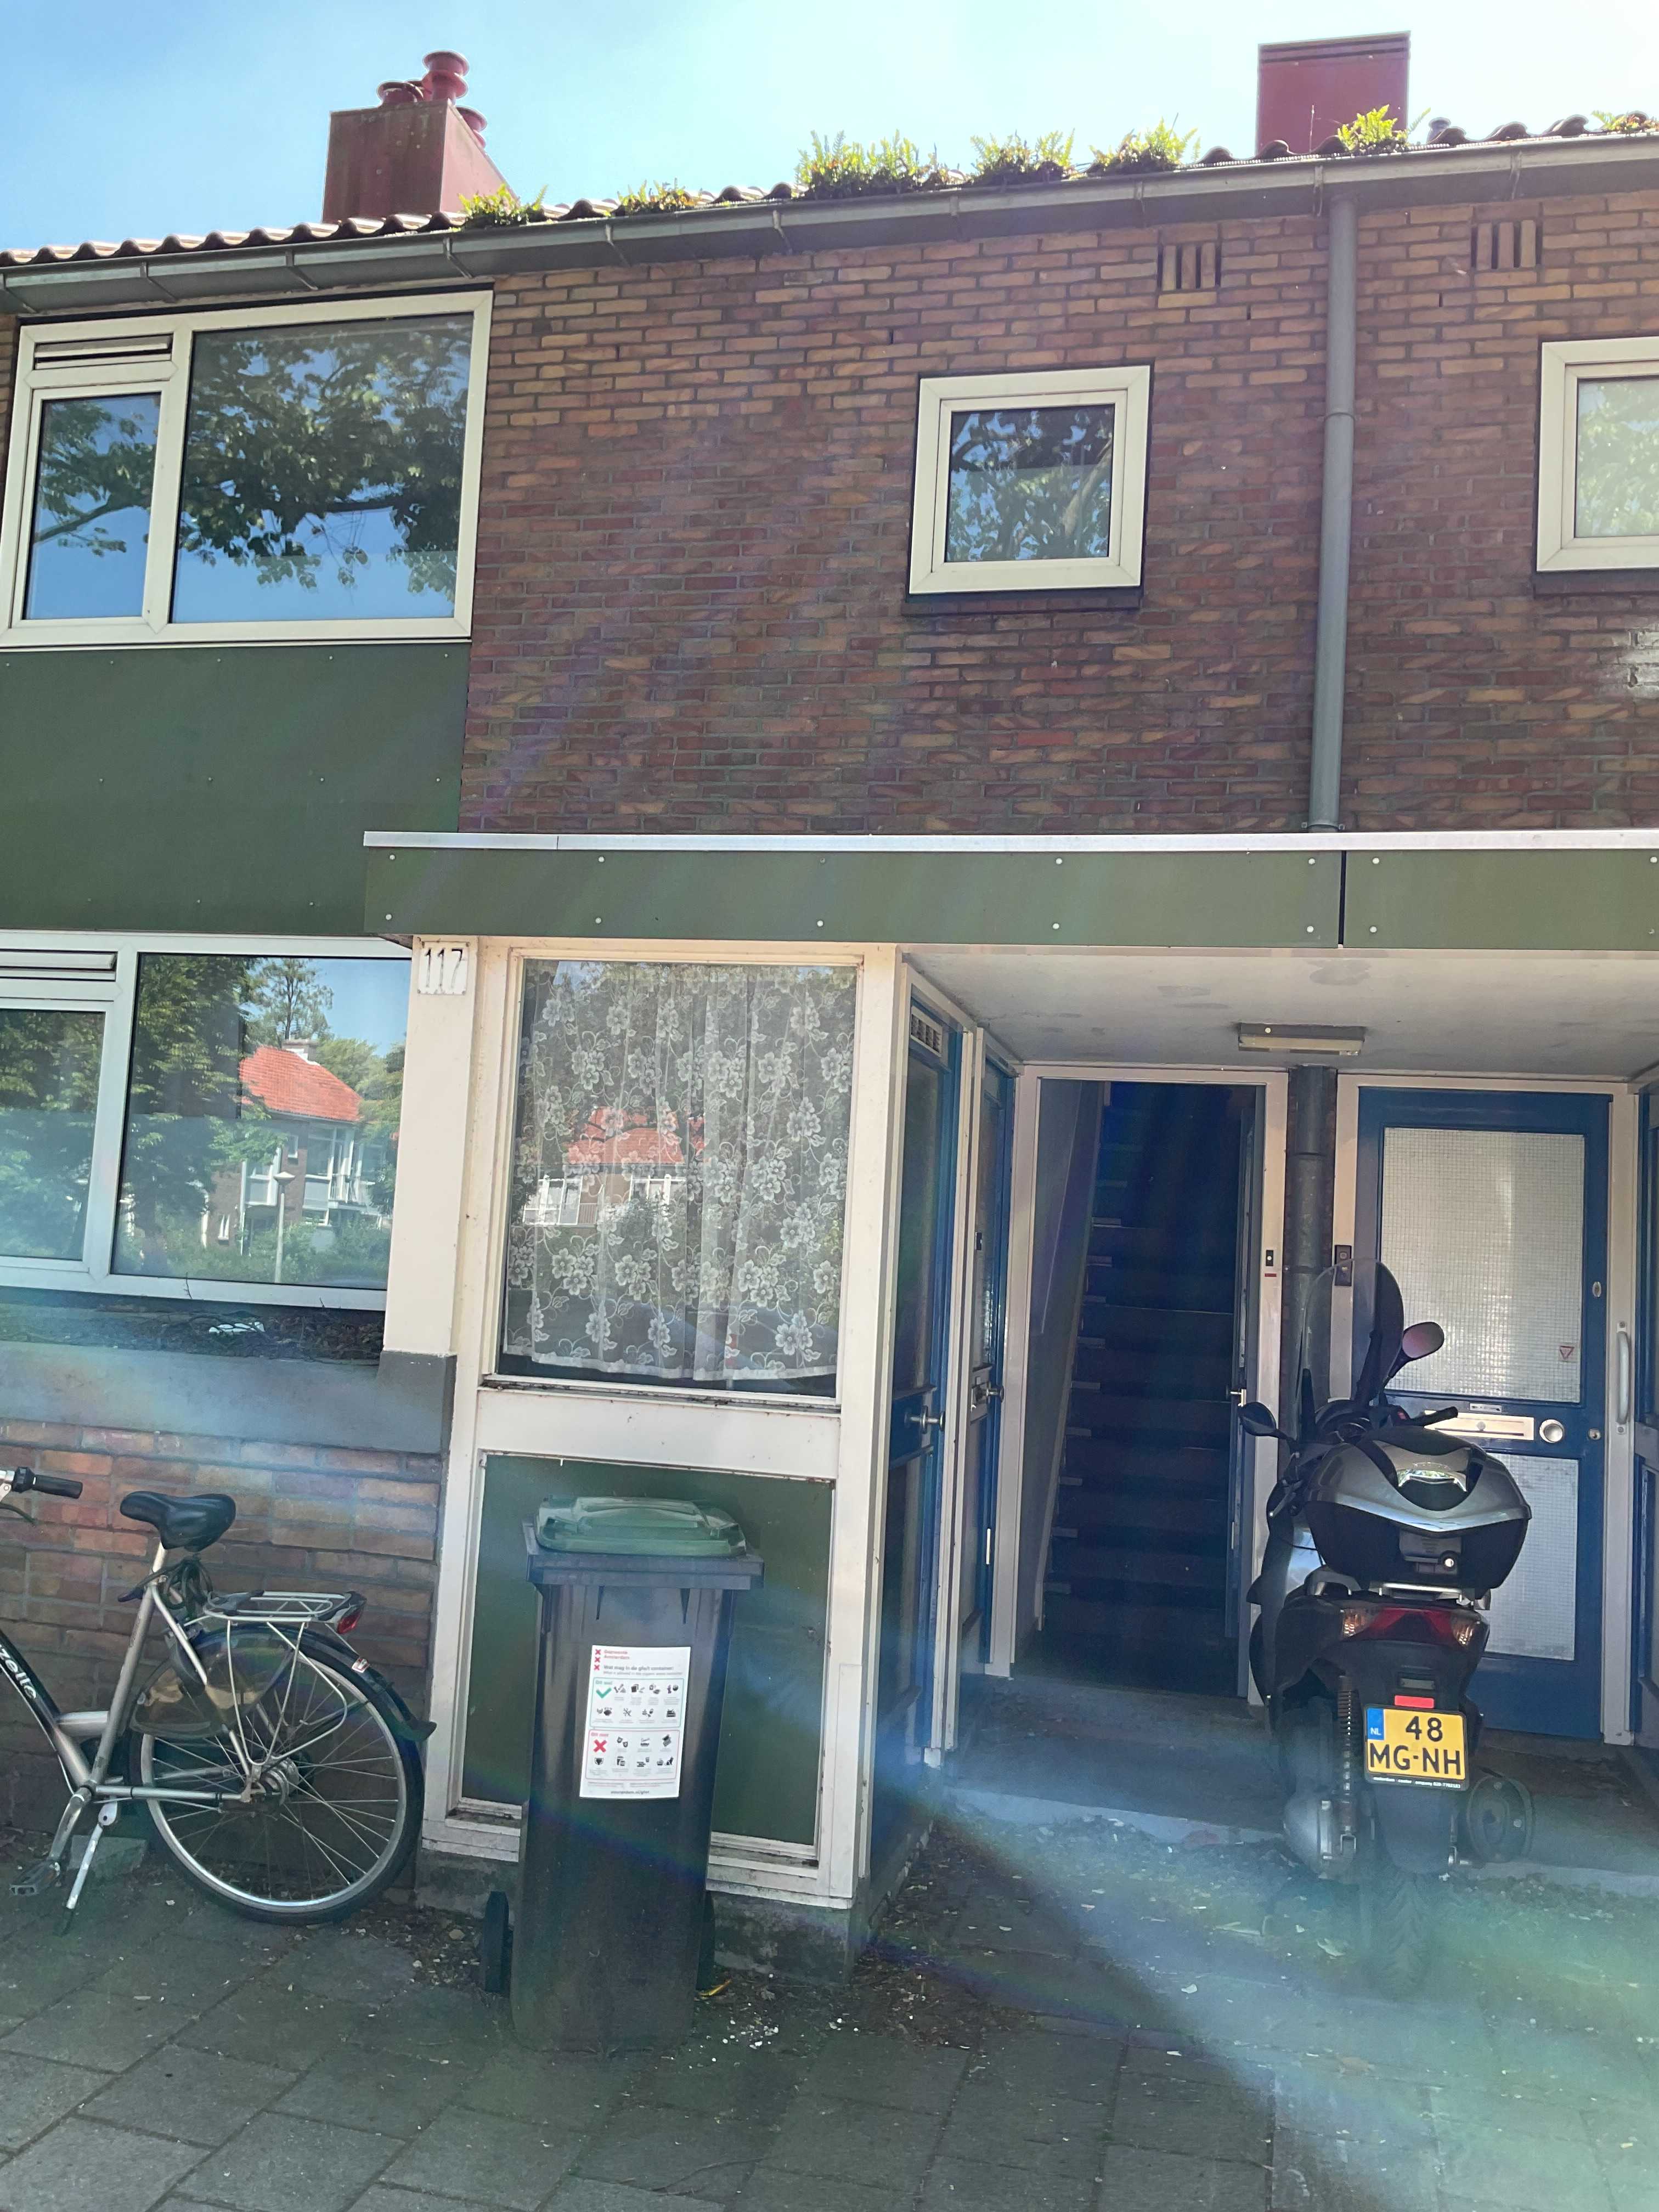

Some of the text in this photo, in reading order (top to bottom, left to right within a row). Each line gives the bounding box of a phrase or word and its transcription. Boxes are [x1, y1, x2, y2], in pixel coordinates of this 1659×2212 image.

[425, 948, 464, 988] 117
[0, 1644, 36, 1699] zelle
[1406, 1716, 1443, 1742] 48
[1370, 1743, 1461, 1775] MG-NH
